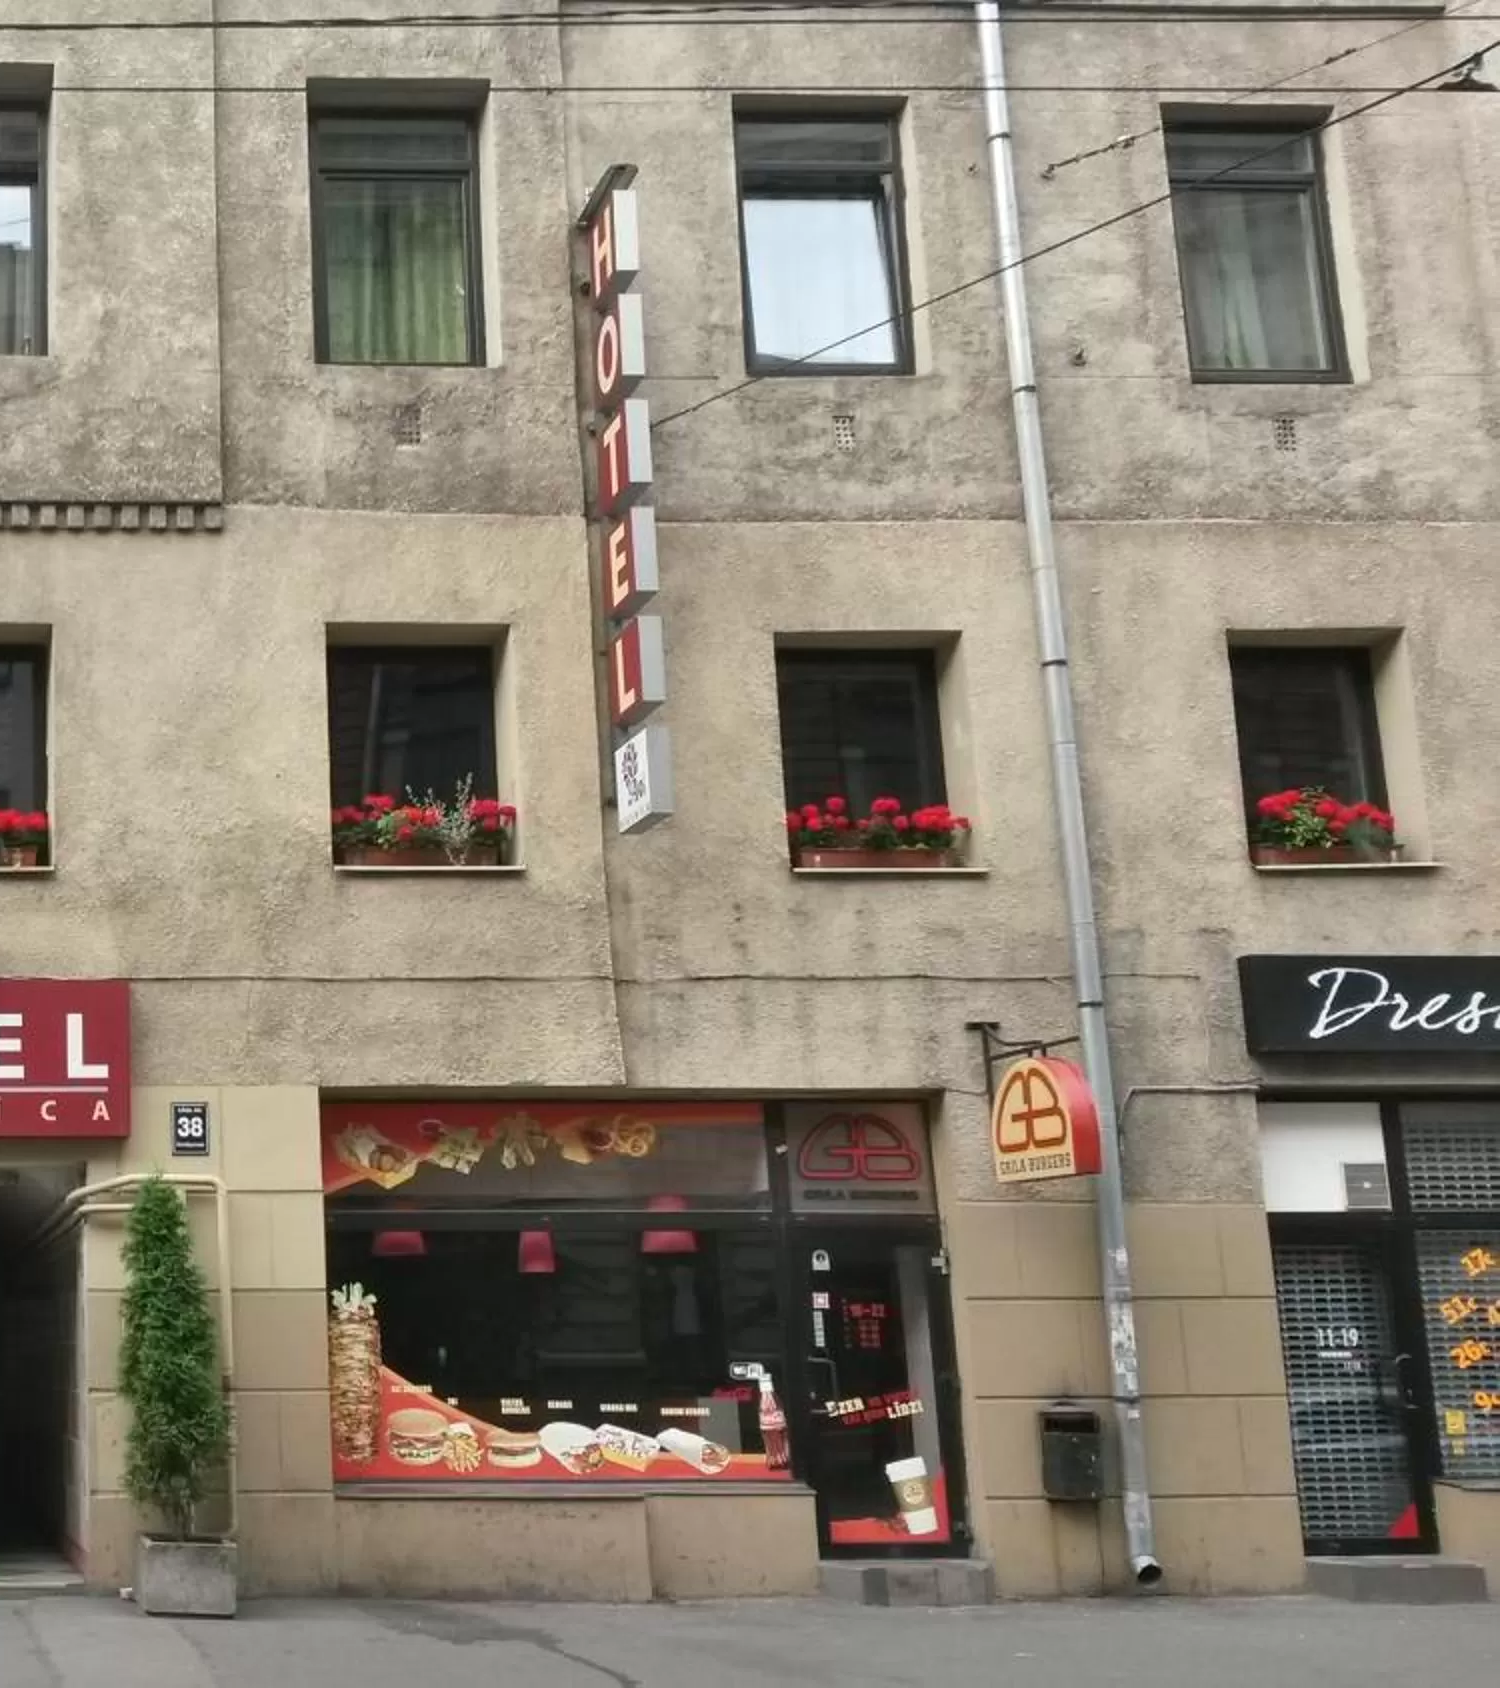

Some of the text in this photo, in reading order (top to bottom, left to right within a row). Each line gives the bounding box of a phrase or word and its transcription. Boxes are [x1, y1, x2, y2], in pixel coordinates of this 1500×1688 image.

[593, 206, 635, 713] HOTEL
[1307, 966, 1500, 1039] Dres
[177, 1116, 203, 1137] 38
[1317, 1327, 1359, 1348] 11-19
